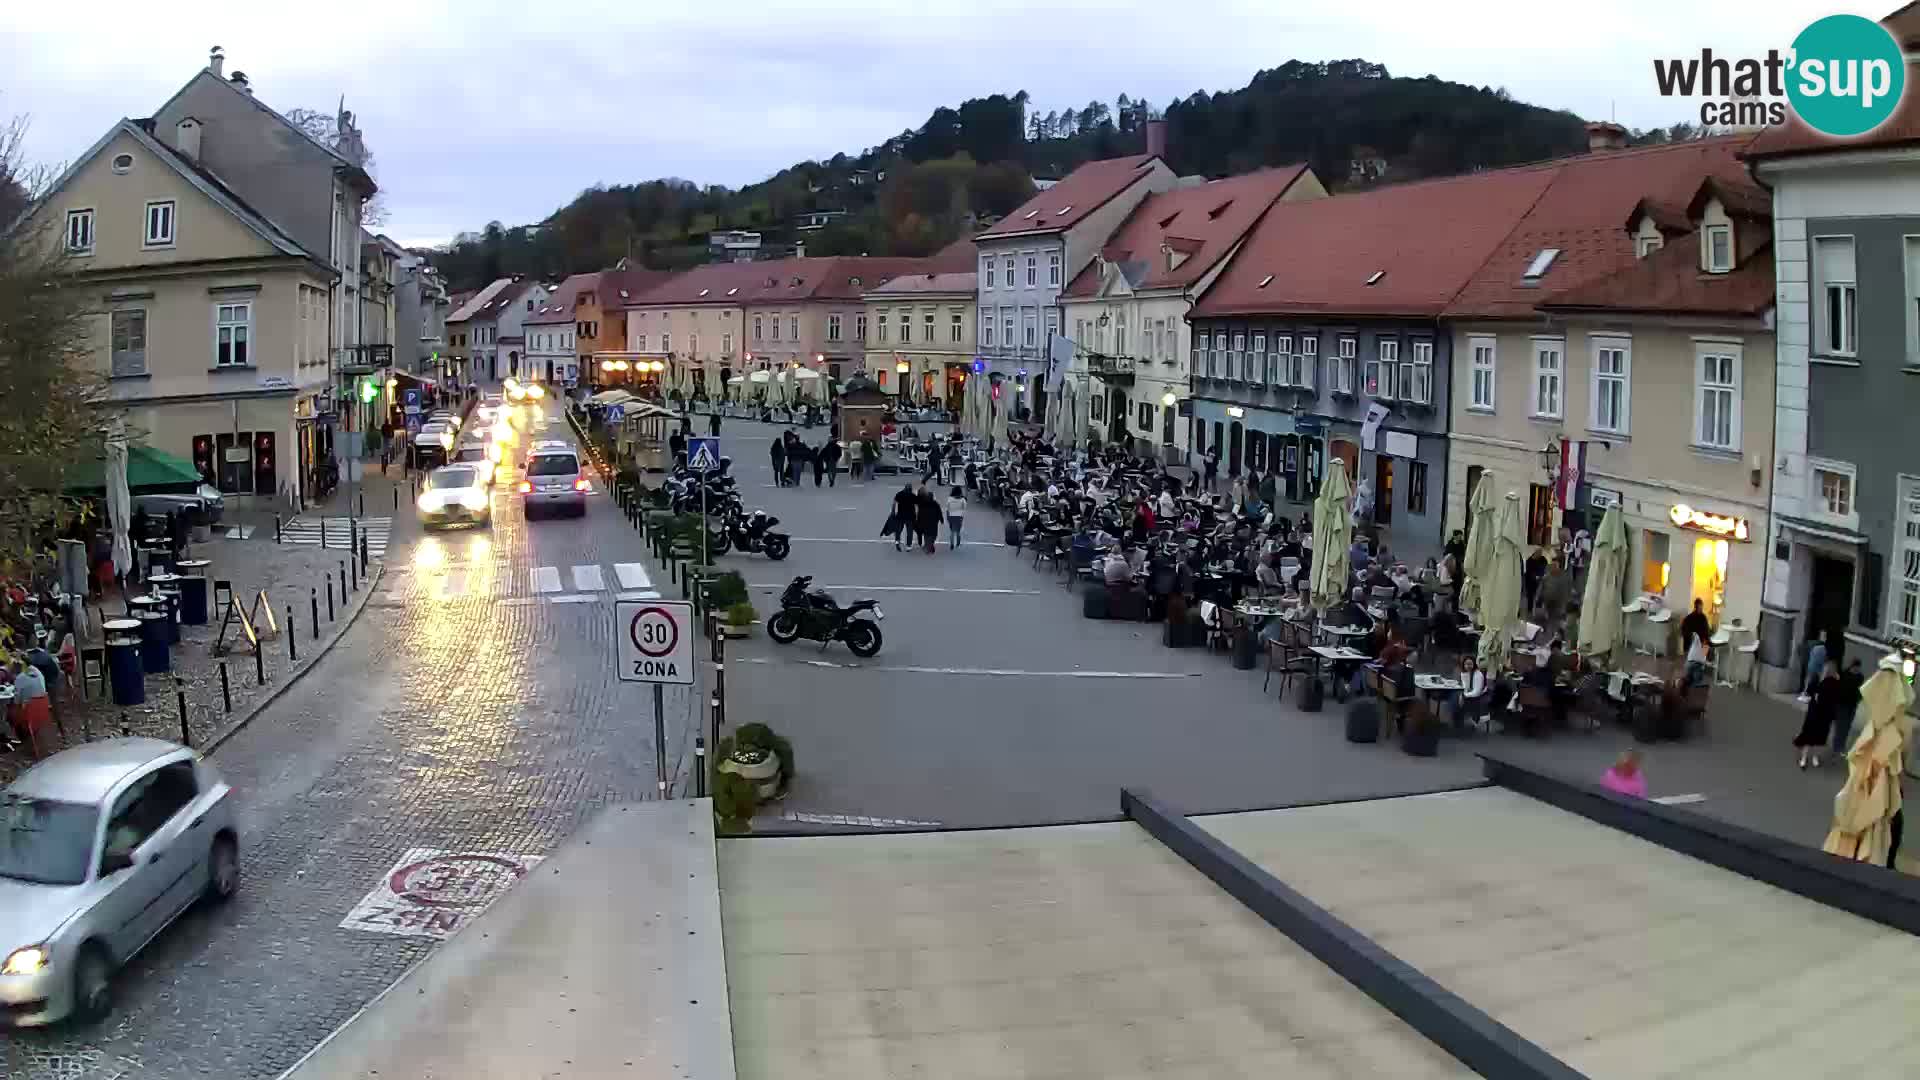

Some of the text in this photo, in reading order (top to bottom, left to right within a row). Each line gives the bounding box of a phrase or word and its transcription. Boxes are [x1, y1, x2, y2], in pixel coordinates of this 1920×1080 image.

[643, 623, 667, 644] 30
[633, 660, 678, 677] ZONA
[359, 906, 462, 931] ZON
